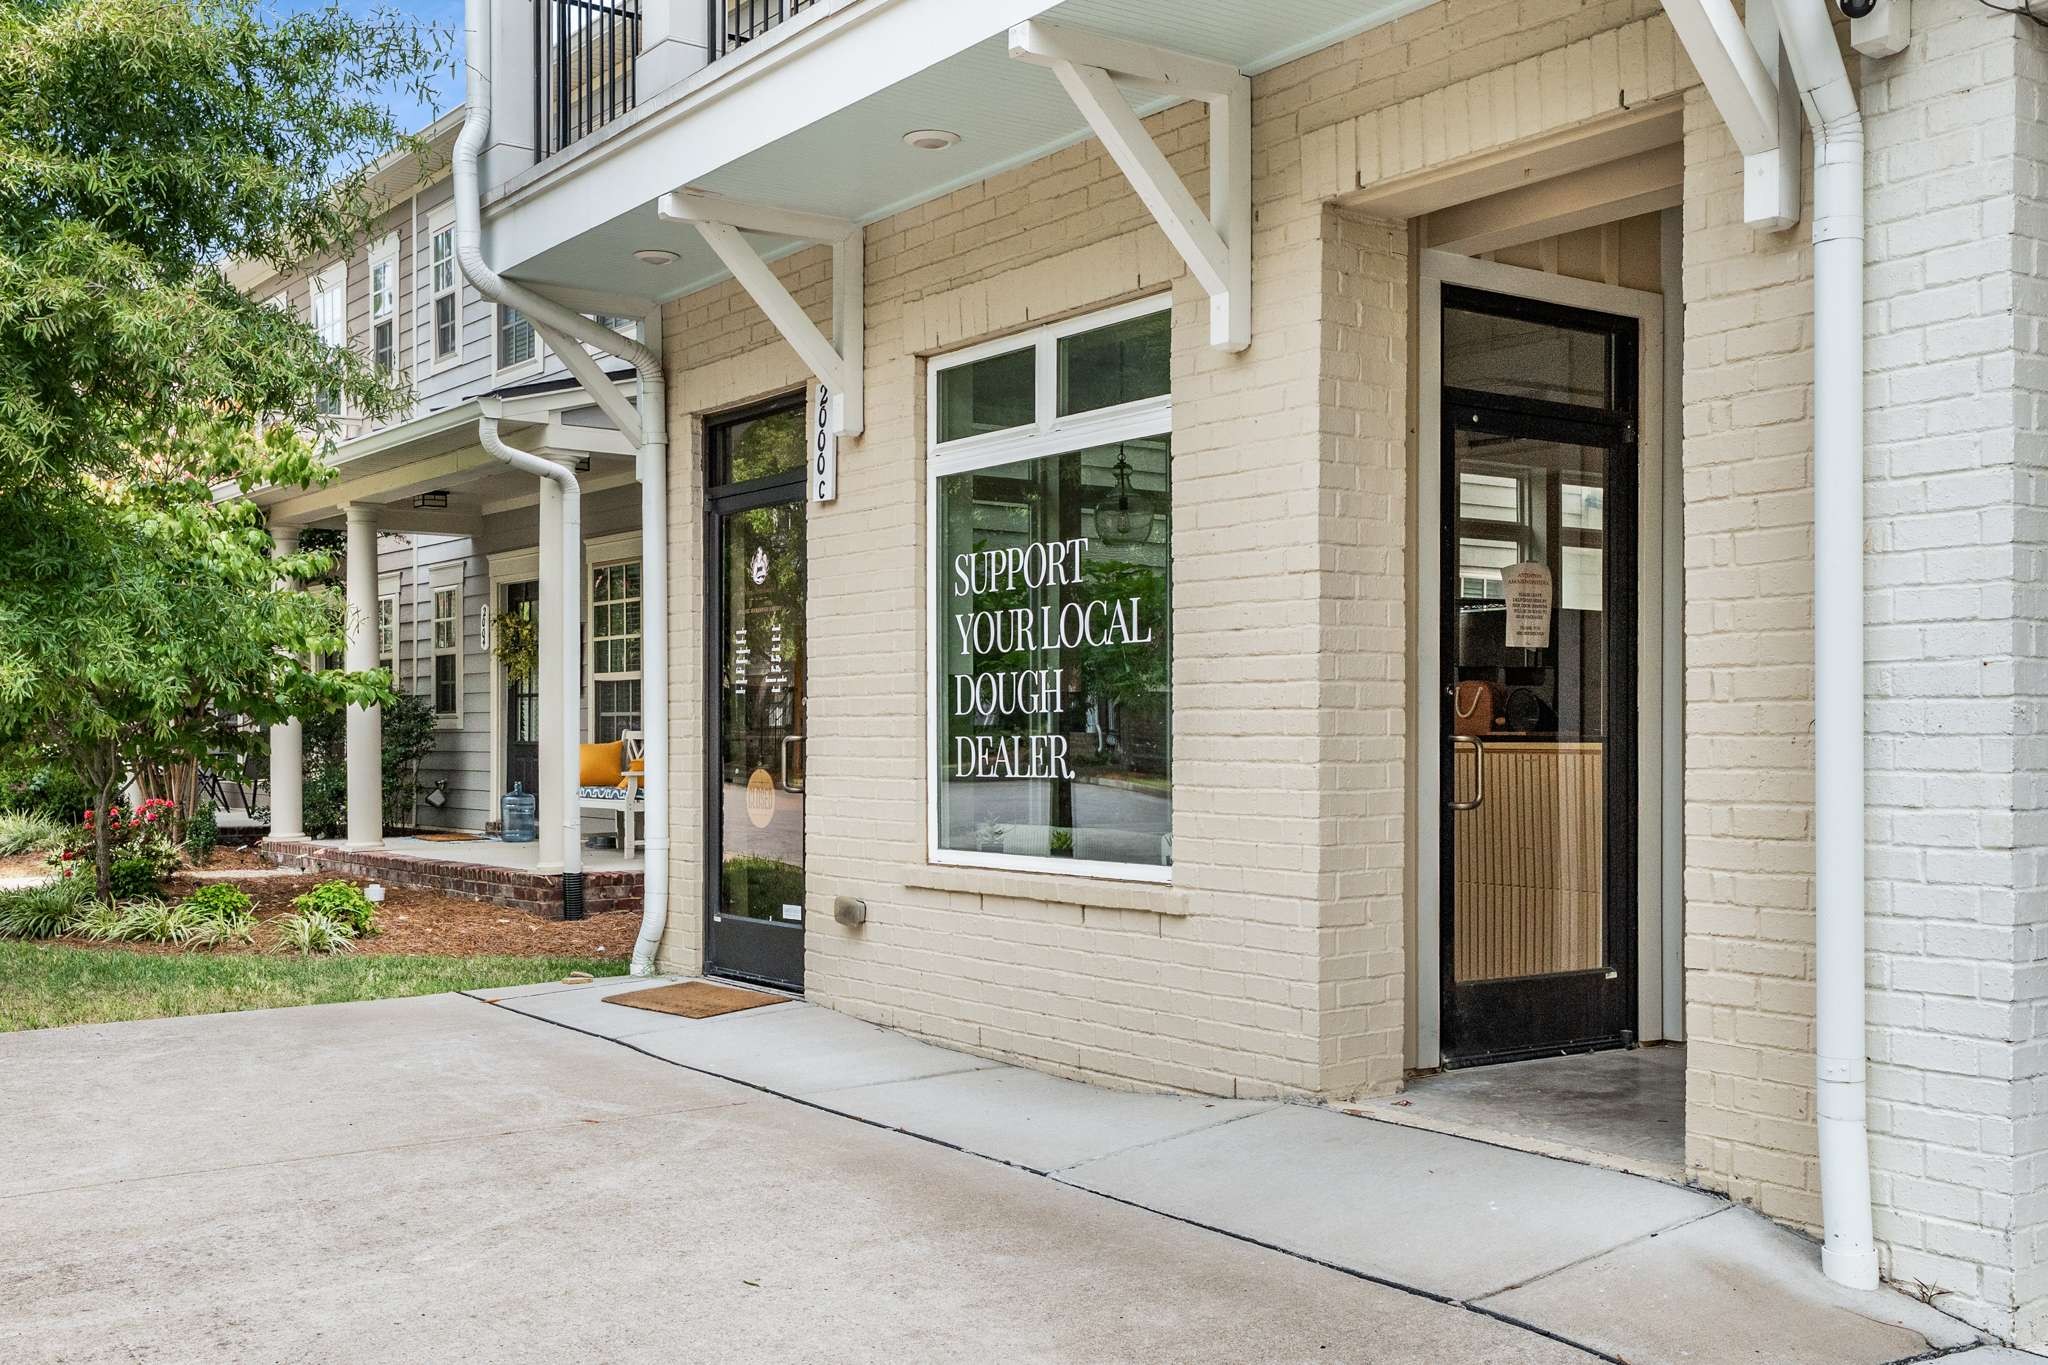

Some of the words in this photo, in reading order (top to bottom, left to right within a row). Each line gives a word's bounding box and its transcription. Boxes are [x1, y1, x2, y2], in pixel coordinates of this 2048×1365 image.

[954, 537, 1089, 597] SUPPORT
[954, 607, 1037, 655] YOUR
[1040, 596, 1152, 650] LOCAL
[954, 668, 1064, 716] DOUGH
[954, 734, 1076, 780] DEALER.
